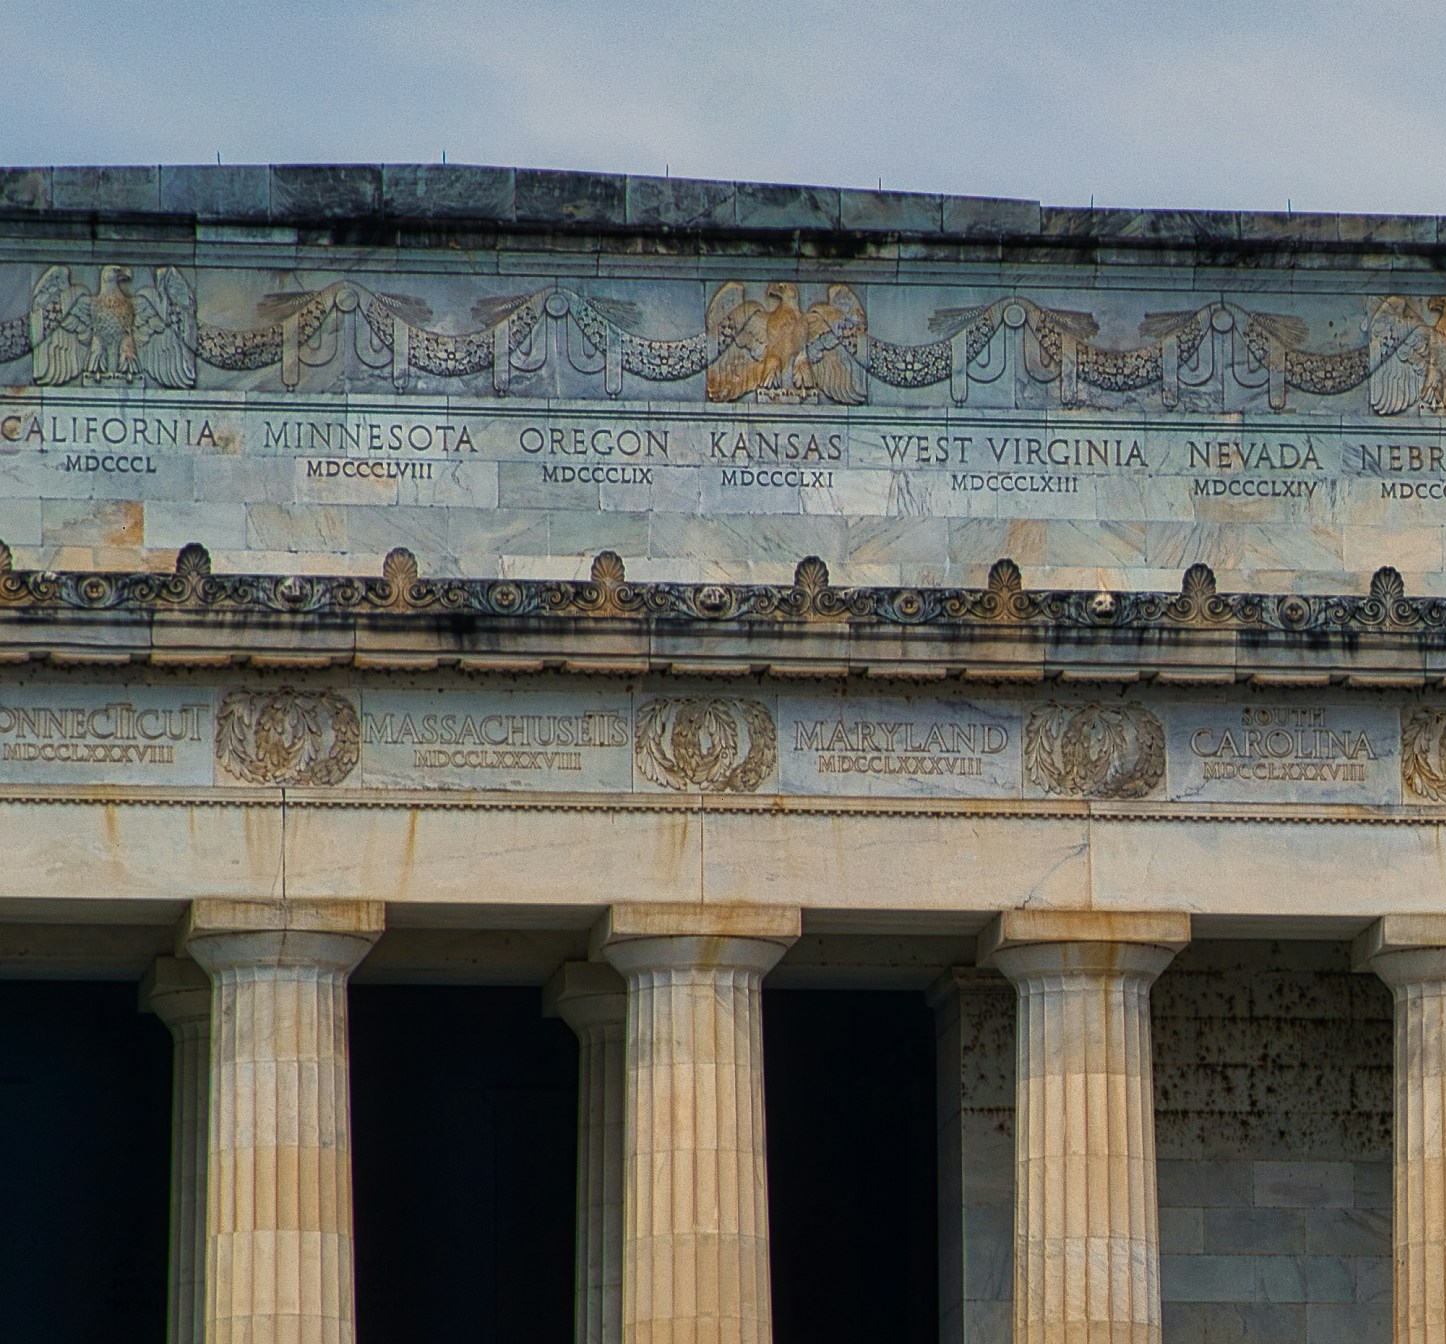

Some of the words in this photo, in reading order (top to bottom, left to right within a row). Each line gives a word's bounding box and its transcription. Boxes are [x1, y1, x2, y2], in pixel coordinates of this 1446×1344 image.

[1, 415, 219, 447] CALIFORNIA
[263, 421, 478, 453] MINNESOTA
[519, 427, 670, 458] OREGON
[710, 431, 842, 461] KANSAS
[881, 435, 973, 464] WEST
[986, 437, 1149, 467] VIRGINIA
[65, 455, 157, 473] MDCCCL
[1188, 441, 1324, 471] NEVADA
[306, 460, 432, 479] MDCCCLVIII
[542, 465, 653, 484] MDCCCLIX
[721, 470, 833, 488] MDCCCLXI
[951, 475, 1079, 493] MDCCCLXIII
[1193, 479, 1318, 497] MDCCCLXIV
[1241, 707, 1326, 727] SOUTH
[363, 710, 629, 747] MASSACHUSETTS
[793, 720, 1009, 754] MARYLAND
[3, 743, 174, 764] MDCCLXXXVIII
[1190, 728, 1378, 760] CAROLINA
[818, 755, 982, 775] MDCCLXXXVIII
[1202, 761, 1365, 781] MDCCLXXXVIII
